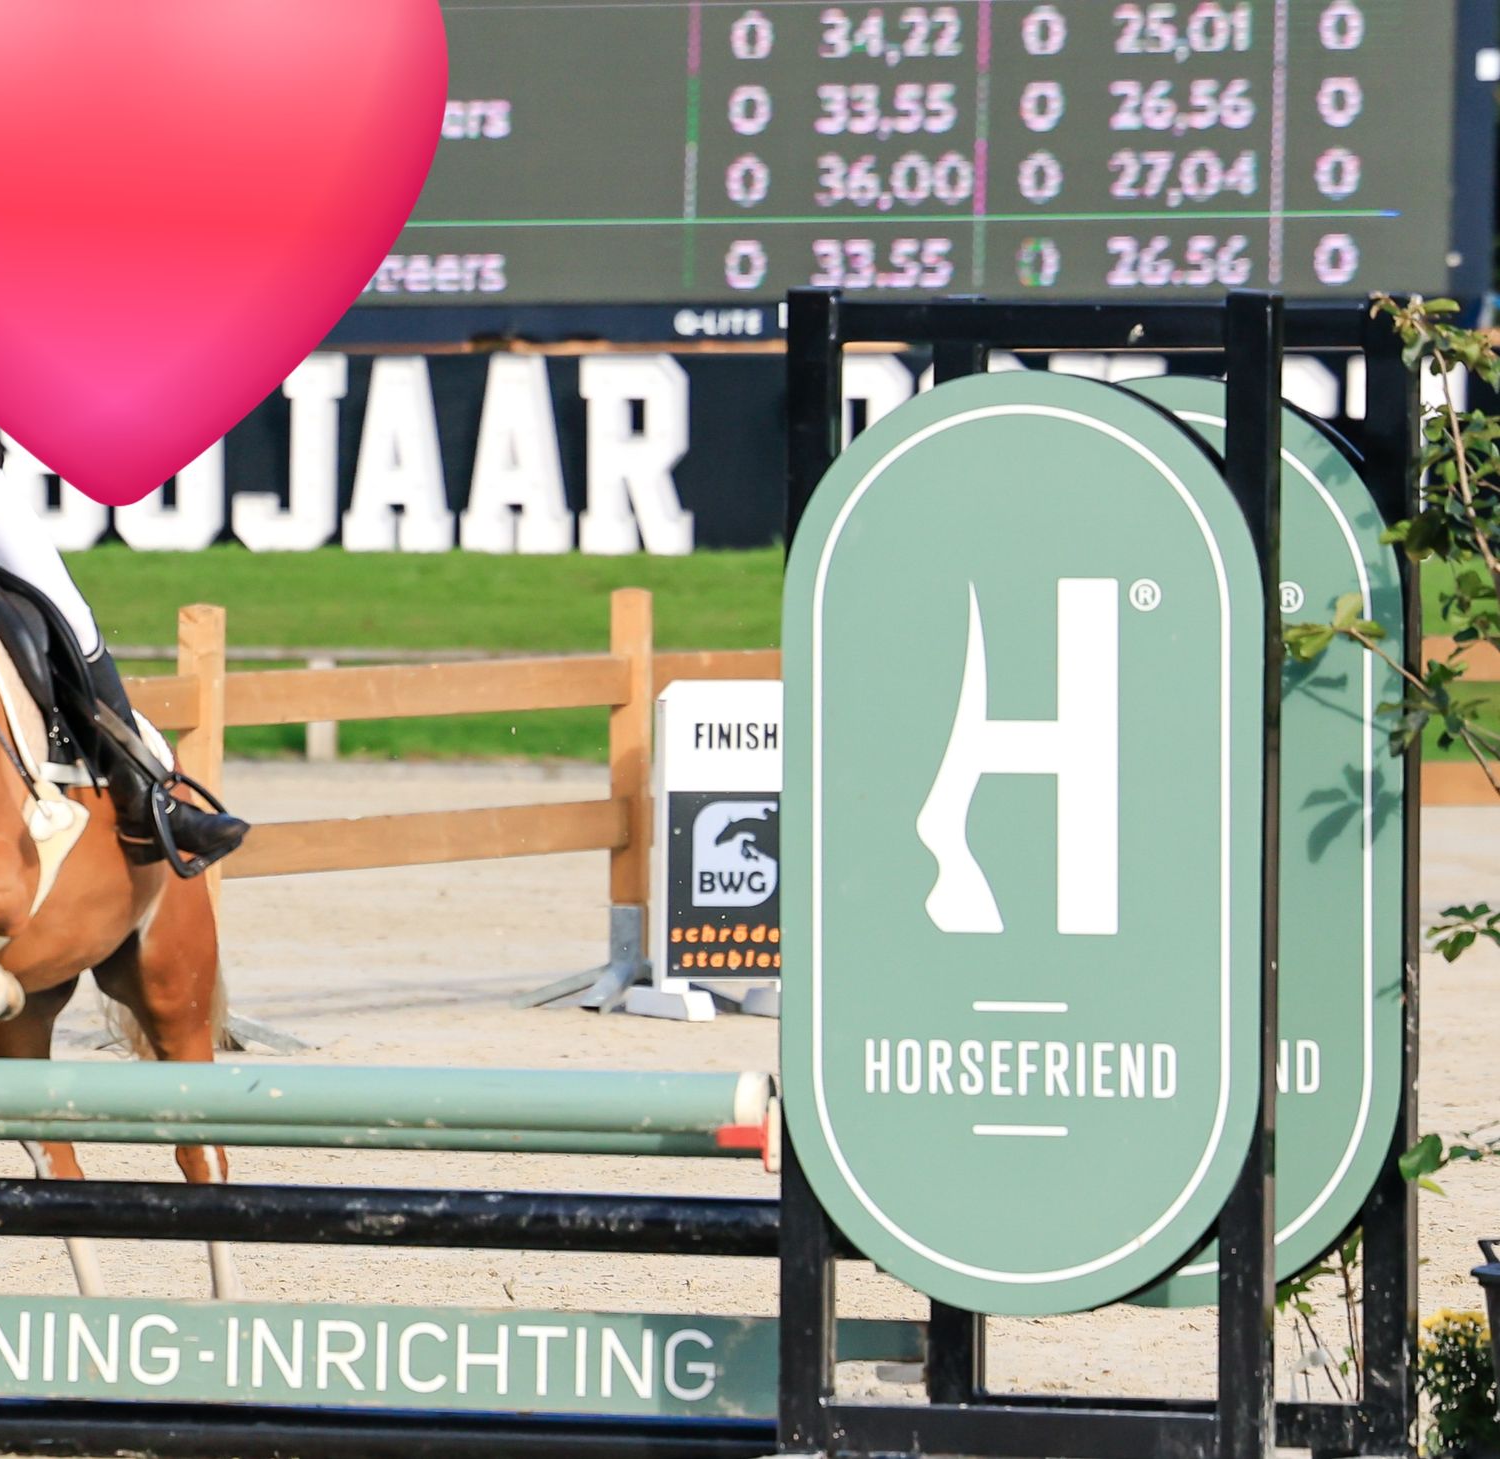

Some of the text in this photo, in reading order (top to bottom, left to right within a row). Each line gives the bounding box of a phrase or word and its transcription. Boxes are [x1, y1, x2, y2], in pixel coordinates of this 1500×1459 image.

[731, 0, 1365, 67] 0 34,22 0 25,01 0
[728, 85, 772, 135] 0
[814, 83, 957, 140] 33,55
[1019, 81, 1065, 132] 0
[1108, 79, 1255, 136] 26,56
[1316, 76, 1363, 128] 0
[725, 146, 1361, 211] 0 36,00 0 27,04 0
[725, 239, 767, 290] 0
[1313, 233, 1359, 285] 0
[695, 722, 778, 750] FINISH
[699, 870, 766, 893] BWG
[864, 1038, 1178, 1099] HORSEFRIEND
